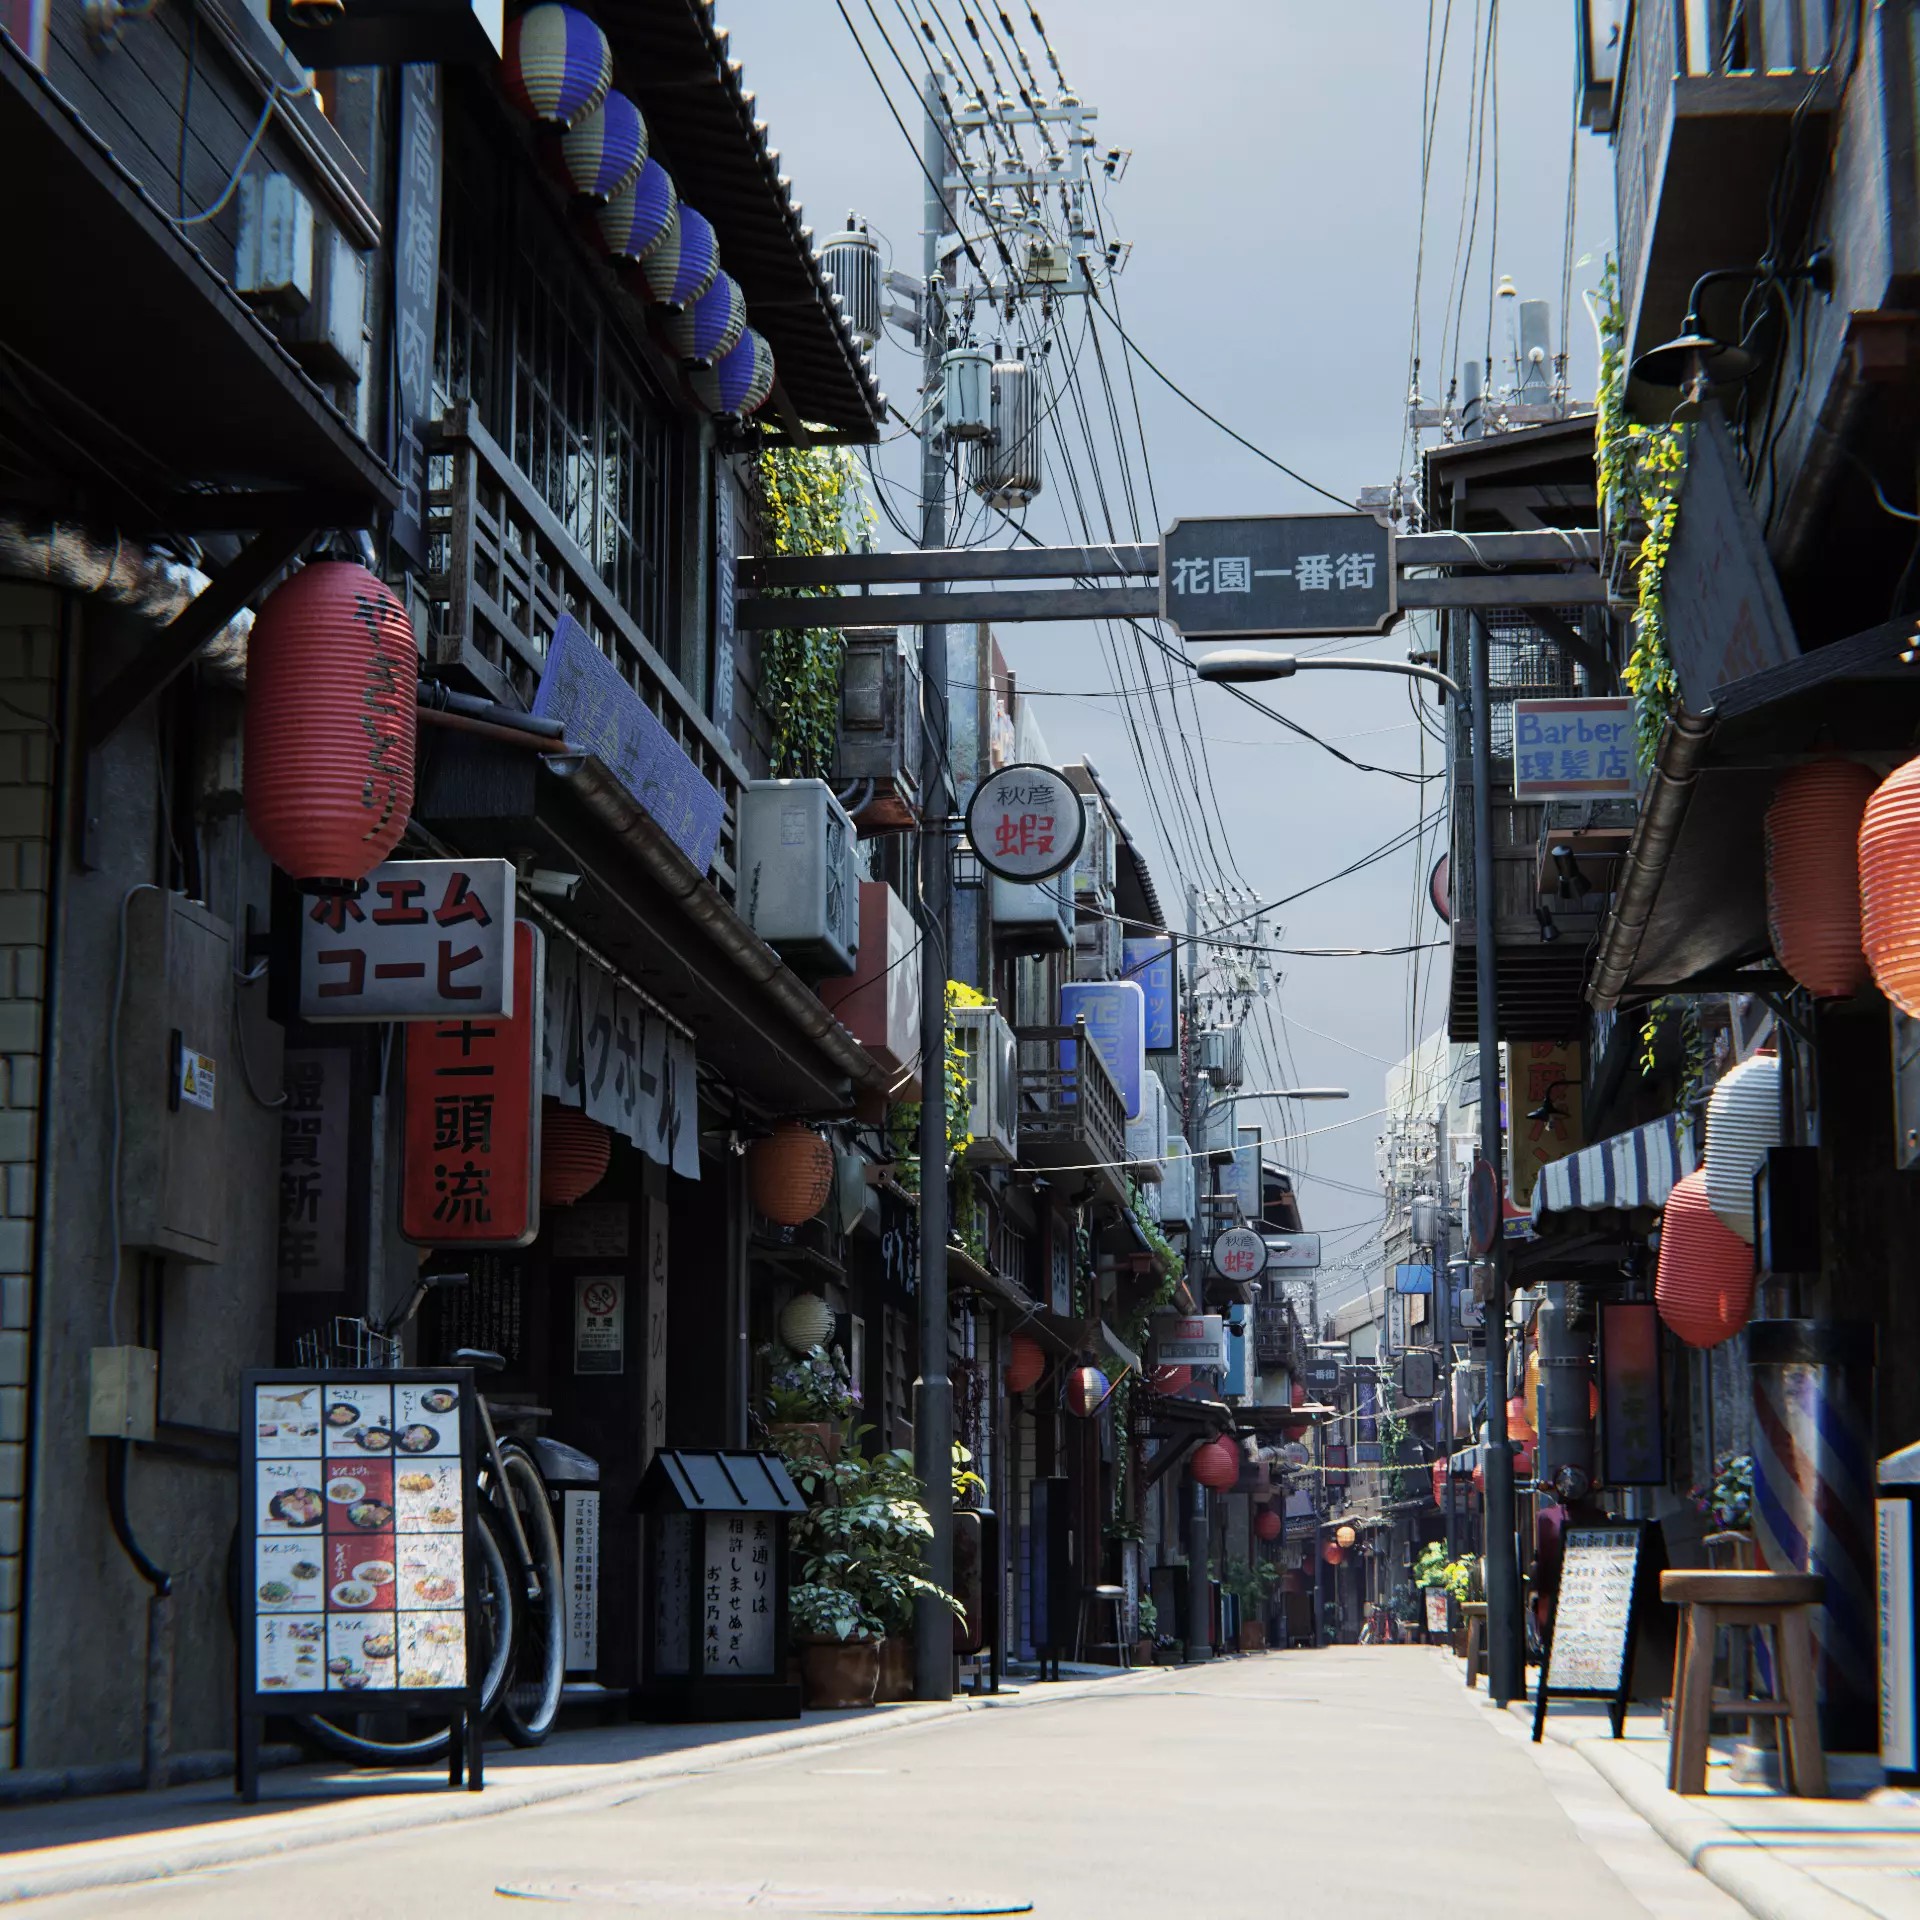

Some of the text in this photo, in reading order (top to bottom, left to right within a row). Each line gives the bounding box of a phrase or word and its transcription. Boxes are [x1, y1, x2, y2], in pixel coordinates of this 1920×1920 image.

[1170, 551, 1378, 596] 花園一番街
[1517, 714, 1626, 746] Barber
[1519, 747, 1628, 780] 理髪店
[997, 785, 1055, 806] 秋彦
[995, 812, 1055, 857] 蝦
[317, 940, 484, 1000] コーヒ
[752, 1521, 769, 1613] 素通りは
